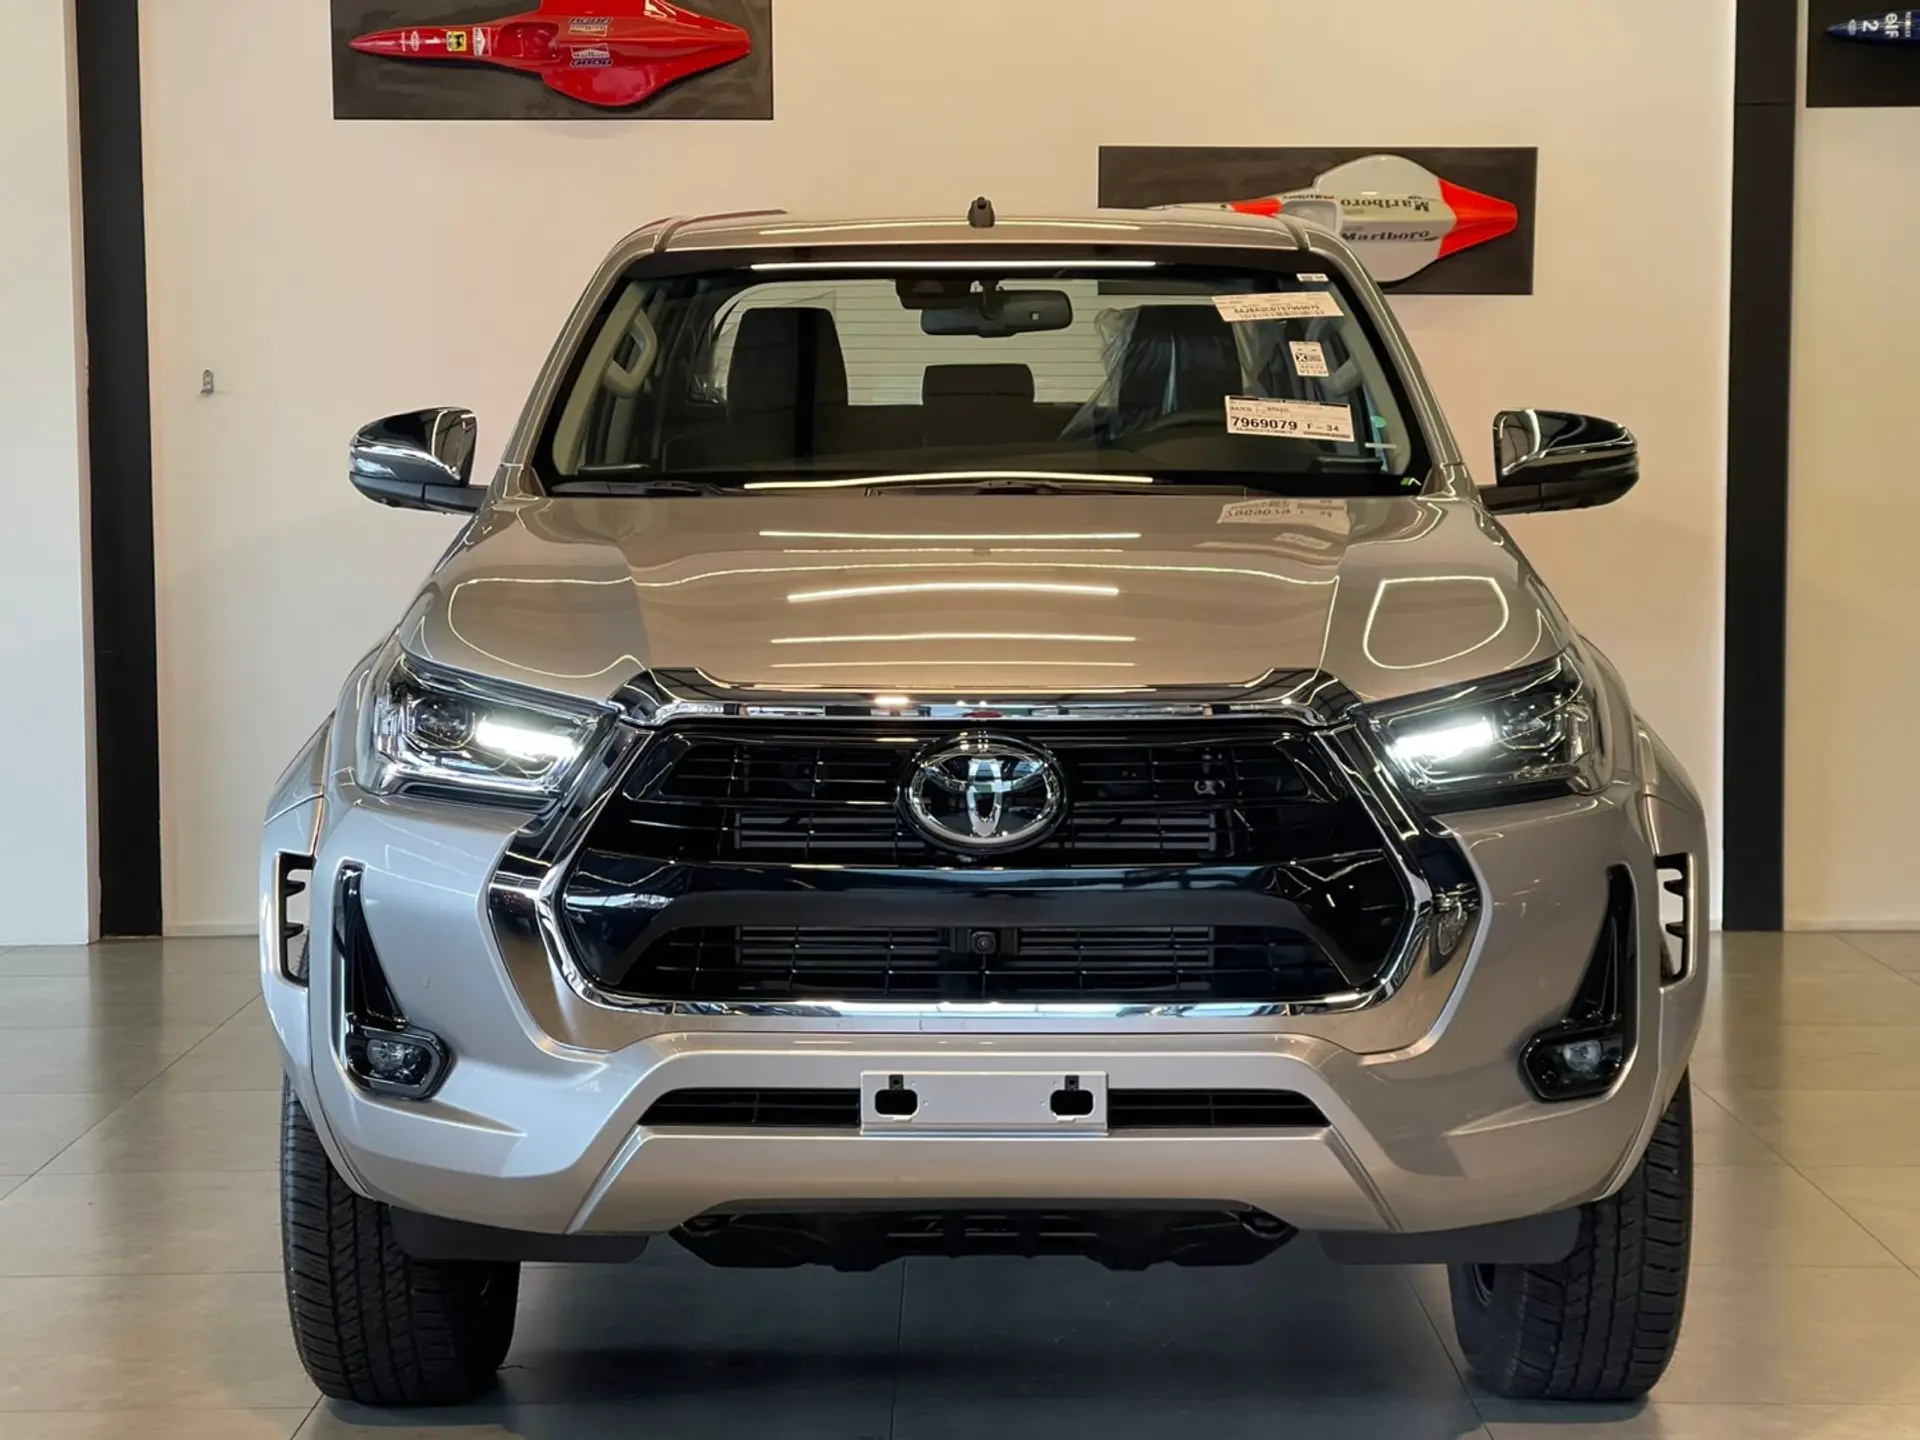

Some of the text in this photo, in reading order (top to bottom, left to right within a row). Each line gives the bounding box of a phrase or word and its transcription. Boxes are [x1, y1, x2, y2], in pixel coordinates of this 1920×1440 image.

[1862, 20, 1879, 32] 2
[1340, 197, 1430, 212] Marlboro
[1341, 230, 1430, 241] Marlboro
[1231, 416, 1298, 431] 7969079
[1326, 424, 1340, 432] 34
